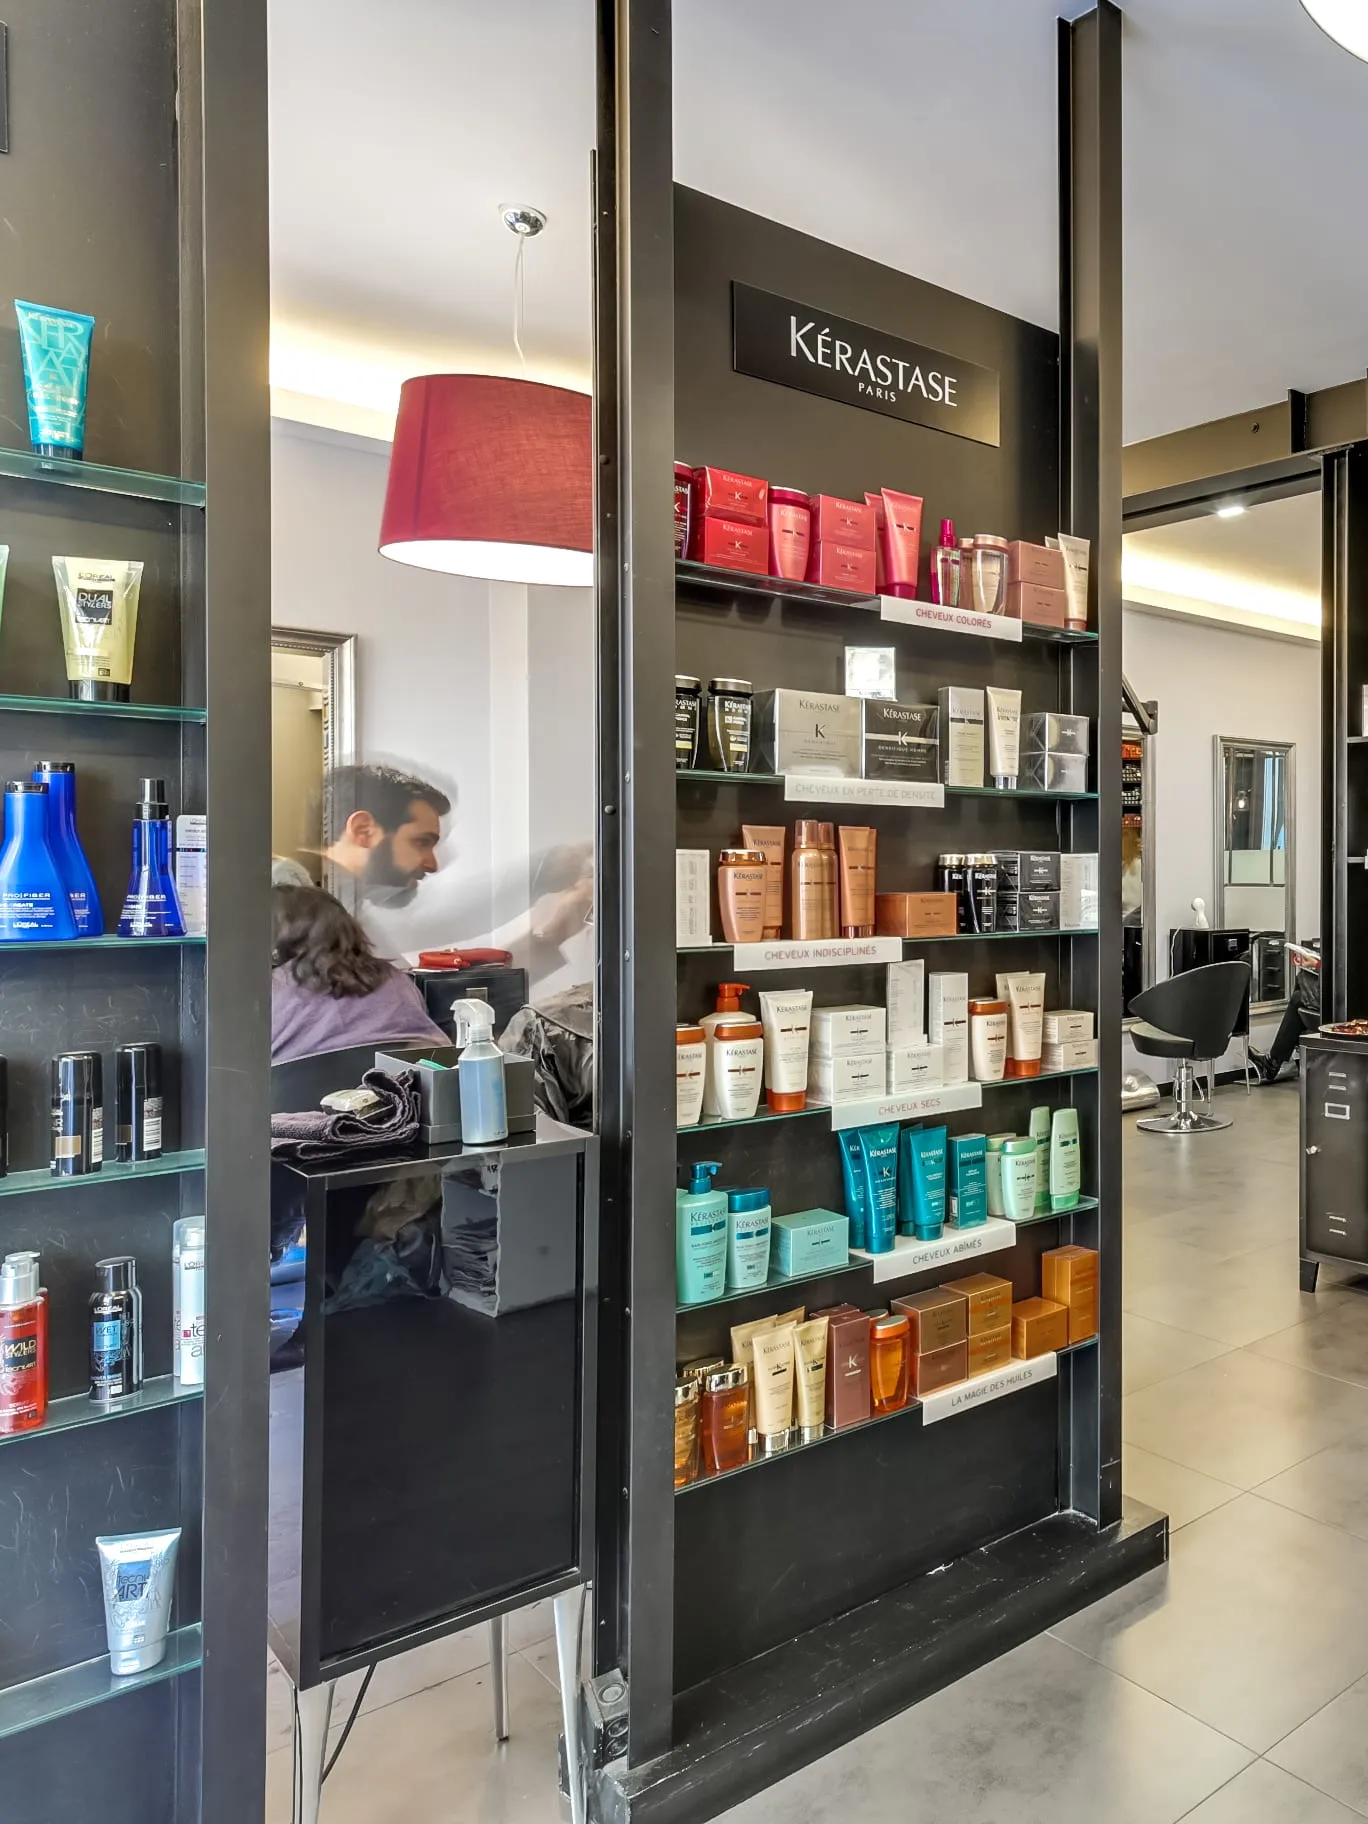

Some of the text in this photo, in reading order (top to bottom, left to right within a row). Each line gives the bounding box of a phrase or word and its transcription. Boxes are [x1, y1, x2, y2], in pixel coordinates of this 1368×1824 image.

[790, 315, 957, 407] KÉRASTASE
[858, 382, 896, 402] PARIS
[78, 592, 112, 603] DUAL
[916, 607, 992, 628] CHEVEUX COLORÉS
[799, 698, 841, 713] KÉRASTASE
[883, 708, 921, 722] KÉRASTASE
[795, 783, 840, 795] CHEVEUX
[842, 785, 855, 796] EN
[857, 786, 884, 798] PERTE
[887, 788, 898, 799] DE
[764, 944, 877, 961] CHEVEUX INDISCIPLINÉS
[879, 1097, 942, 1116] CHEVEUX SECS
[912, 1238, 983, 1265] CHEVEUX ABÎMÉS
[5, 1340, 36, 1354] WILD
[952, 1369, 1032, 1407] LA MAGIE DES HUILES
